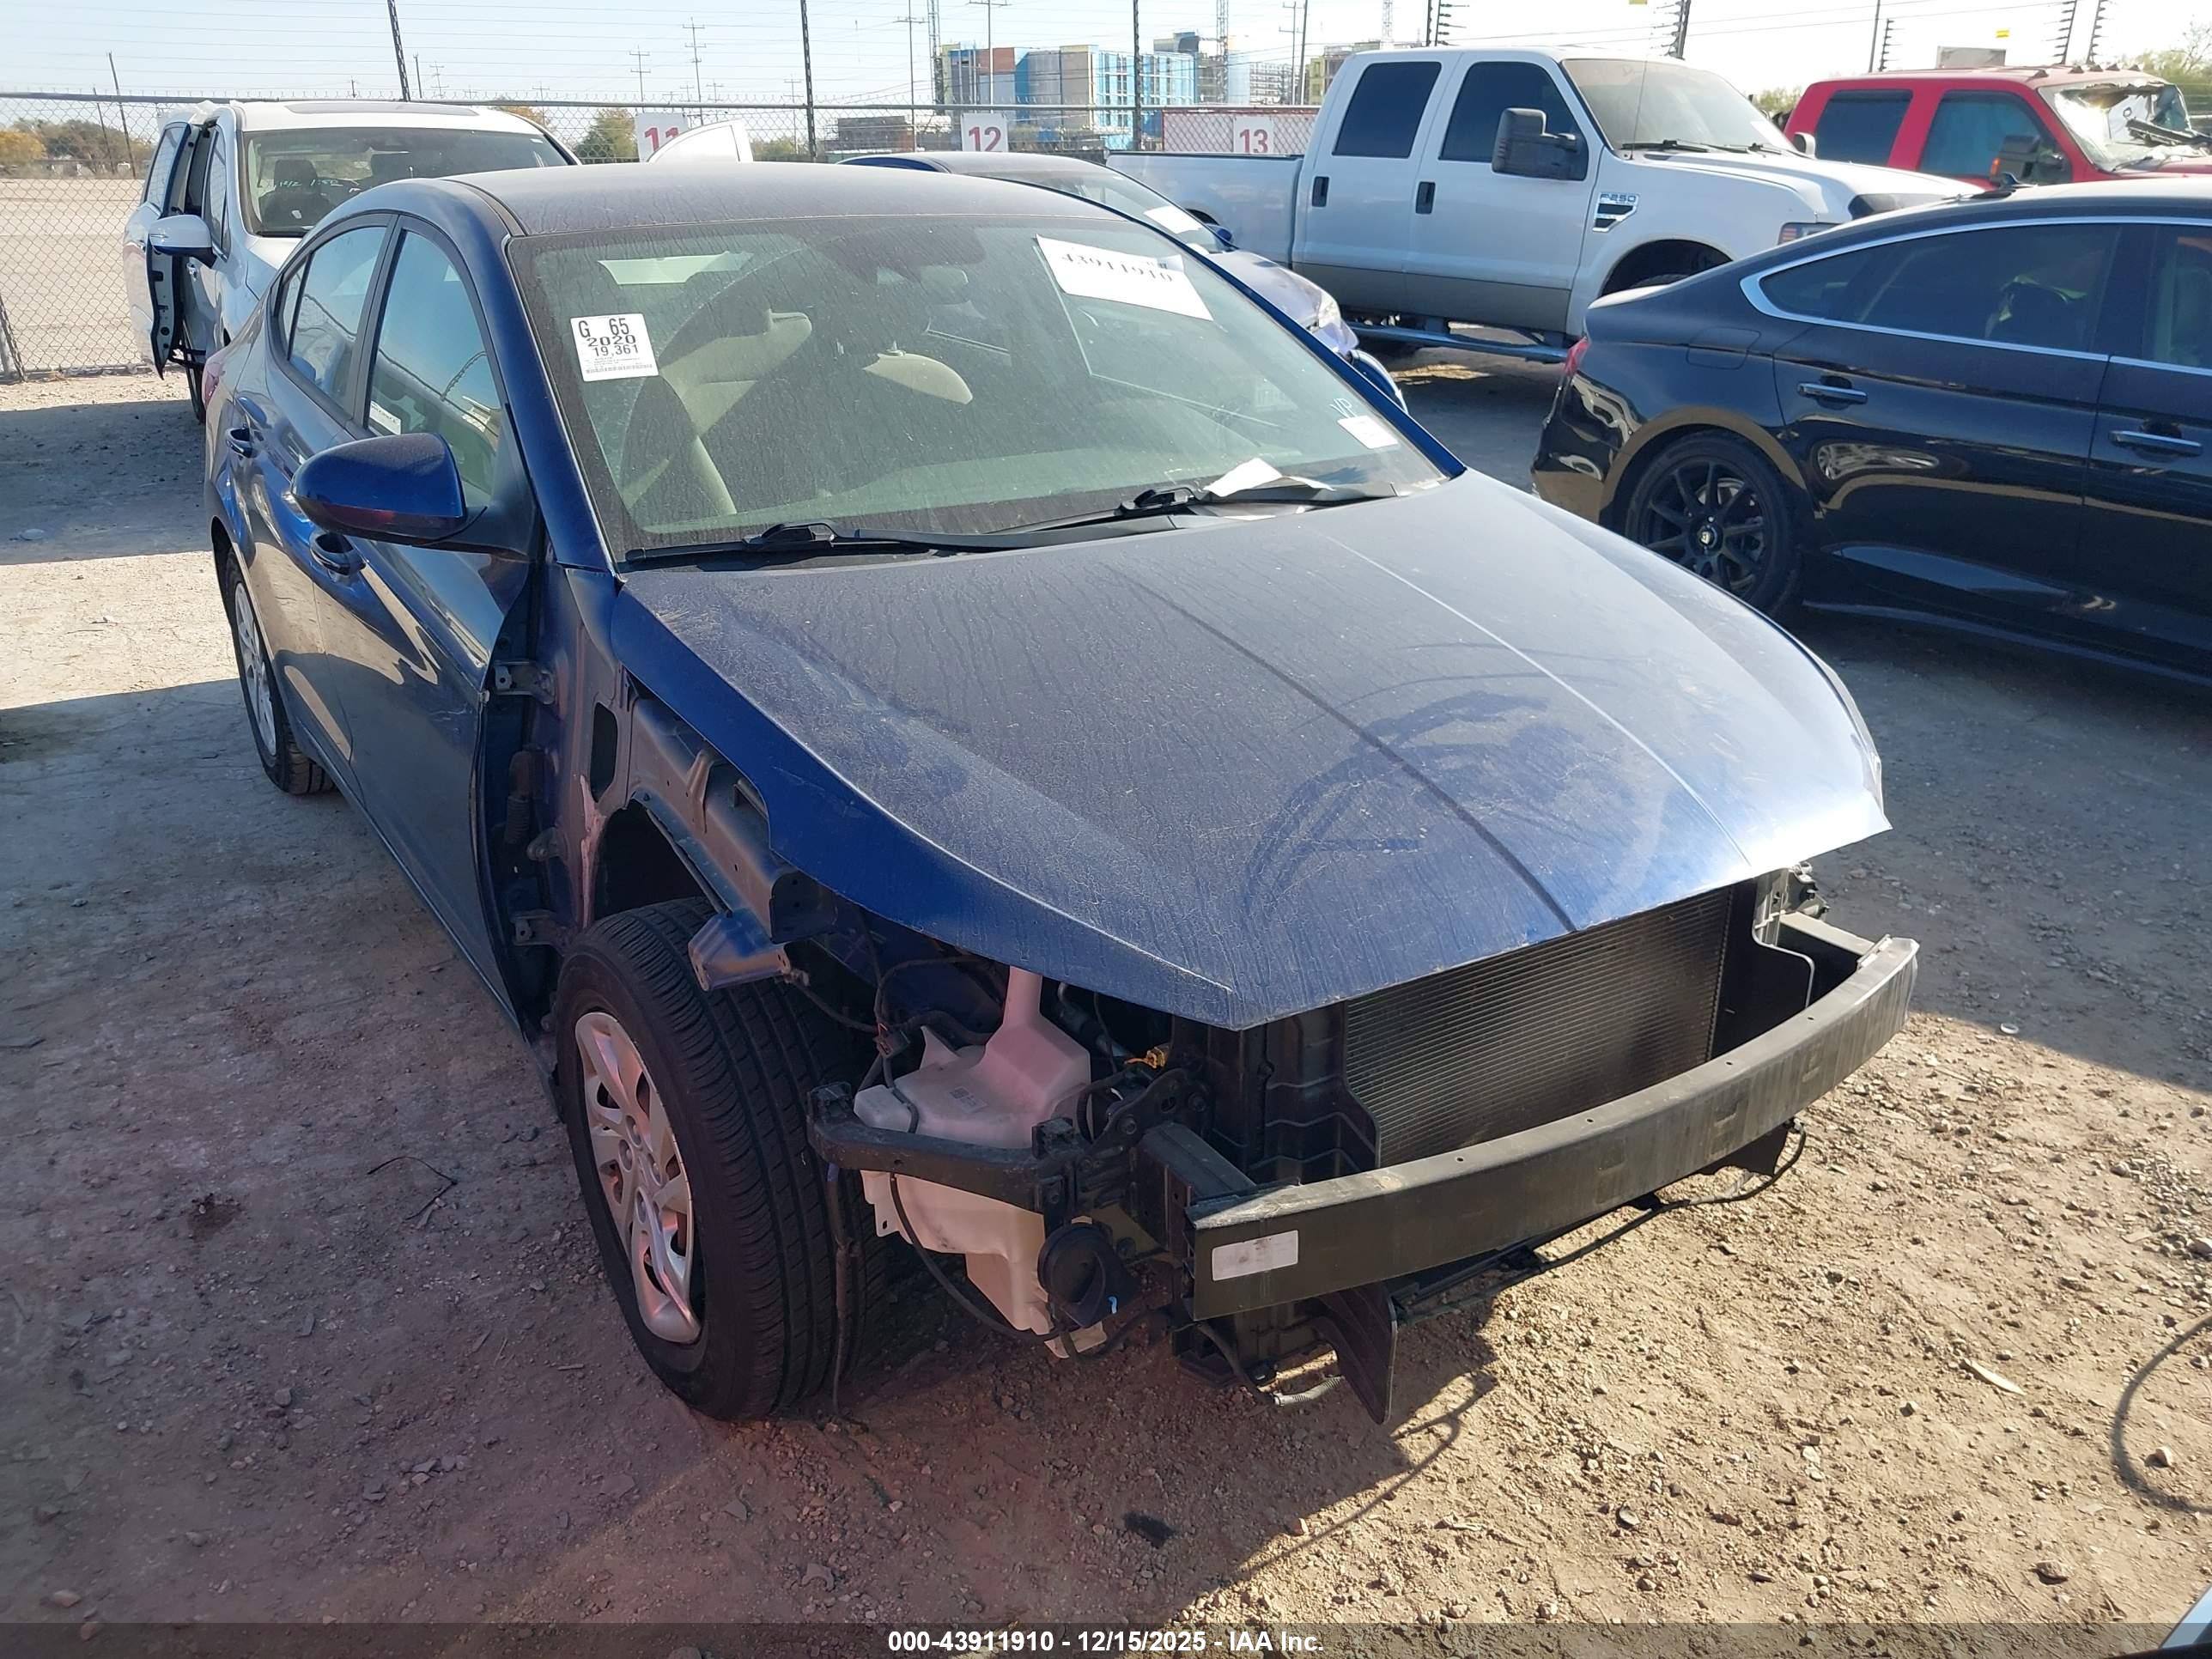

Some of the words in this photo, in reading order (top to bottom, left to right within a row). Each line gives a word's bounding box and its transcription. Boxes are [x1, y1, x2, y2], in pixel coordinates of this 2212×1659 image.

[969, 126, 1001, 151] 12
[1240, 129, 1267, 153] 13
[578, 320, 591, 338] G
[609, 318, 629, 336] 65
[586, 335, 636, 347] 2020
[592, 344, 639, 357] 19,361
